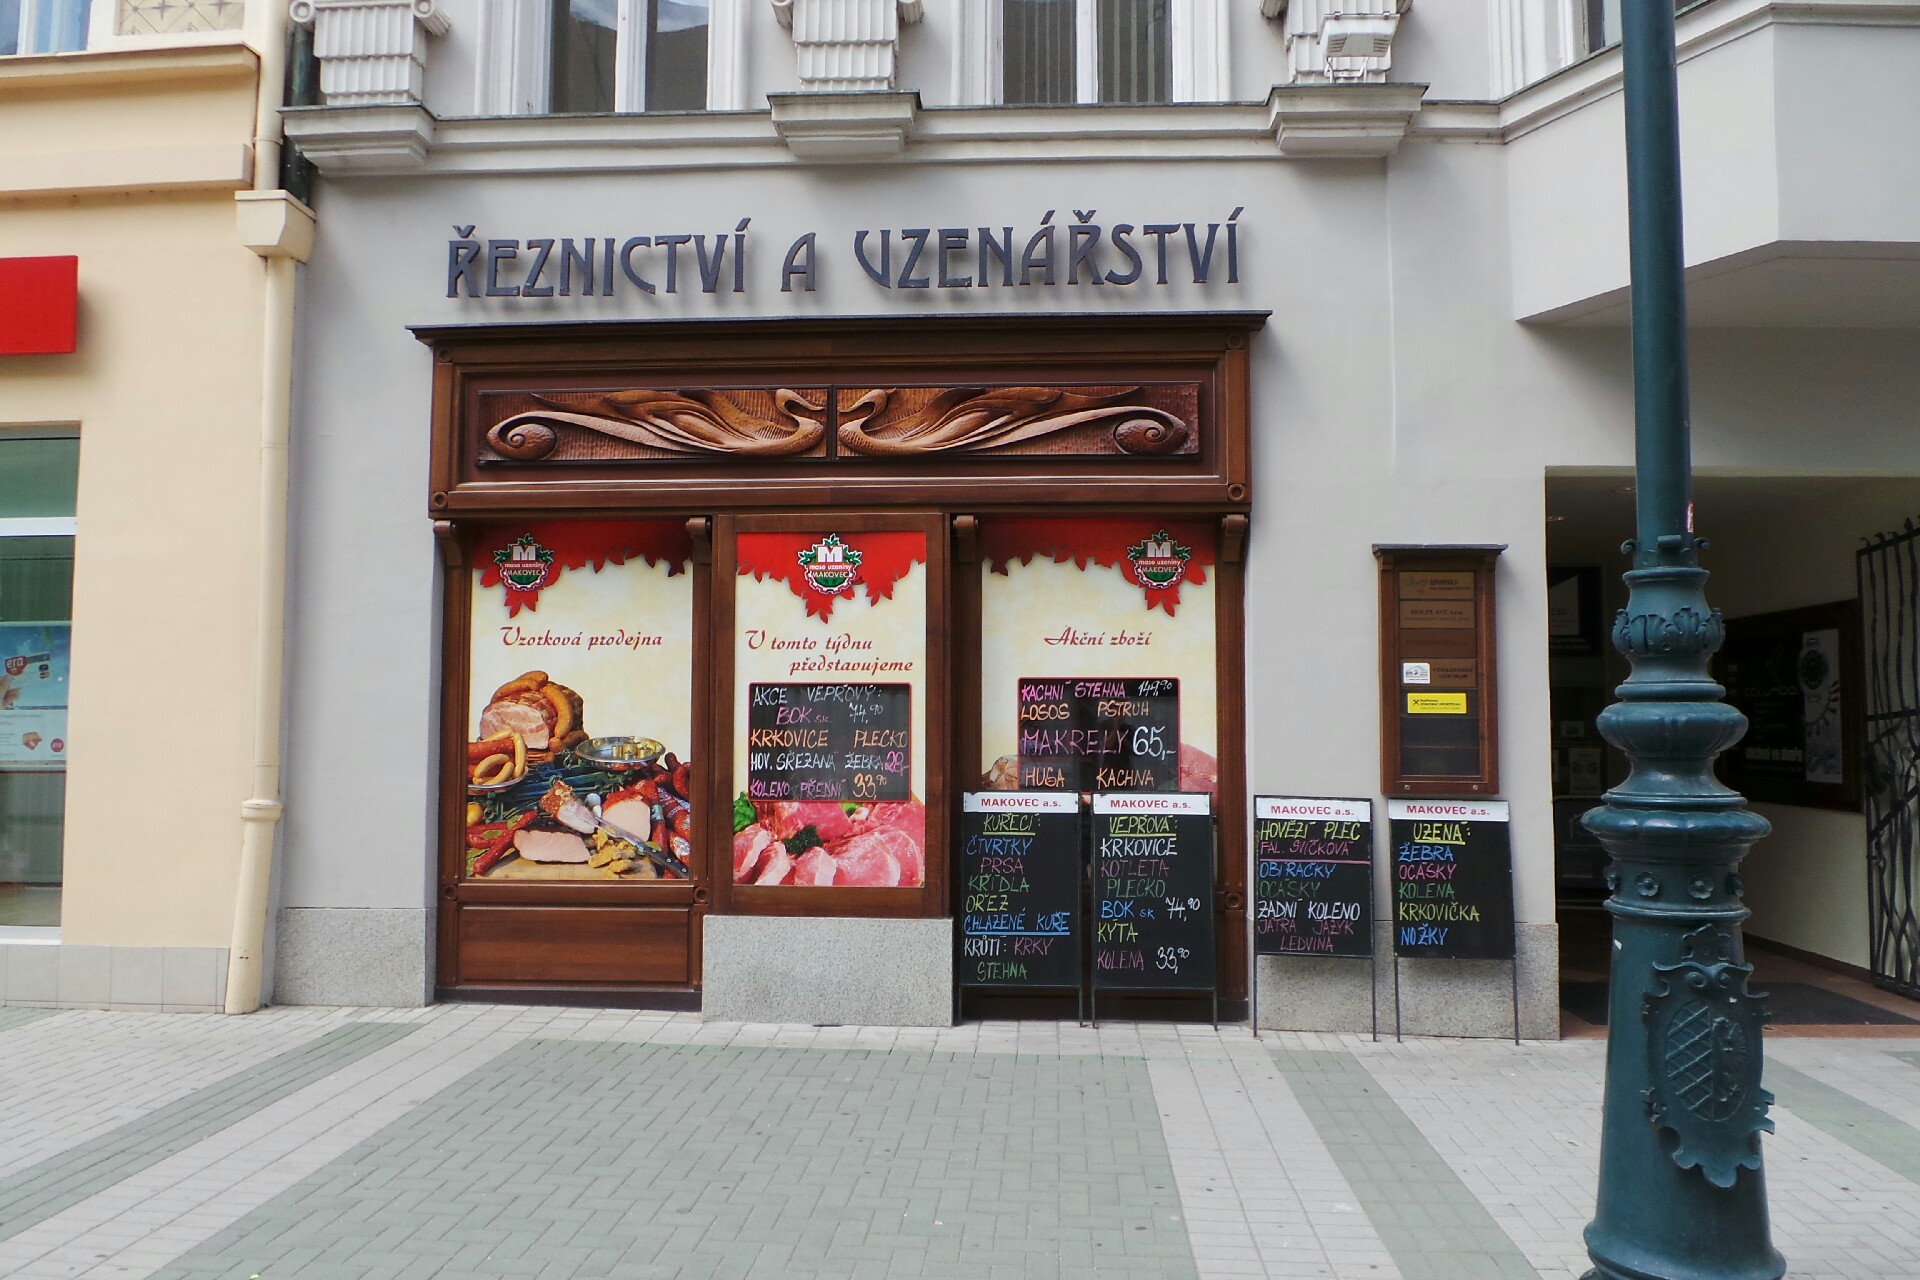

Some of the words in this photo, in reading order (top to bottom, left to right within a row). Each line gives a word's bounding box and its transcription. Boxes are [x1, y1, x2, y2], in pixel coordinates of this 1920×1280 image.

[447, 218, 752, 298] ŘEZNICTVÍ
[781, 232, 817, 293] A
[854, 207, 1244, 289] UZENÁŘSTVÍ
[587, 629, 662, 651] prodejna
[771, 637, 817, 650] tomto
[826, 633, 872, 655] týdnu
[1043, 626, 1105, 646] Akční
[1110, 629, 1153, 646] zboží
[790, 654, 913, 676] představujeme
[753, 686, 788, 707] AKCE
[1074, 682, 1126, 698] STEHNA
[776, 706, 812, 725] BOK
[1021, 703, 1070, 721] LOSOS
[1098, 700, 1149, 717] PSTRUH
[751, 728, 829, 749] KRKOVICE
[854, 729, 908, 748] PLECKO
[1023, 729, 1129, 756] MAKRELY
[751, 753, 774, 772] HOV.
[1096, 767, 1155, 790] KACHNA
[981, 798, 1039, 807] MAKOVEC
[1042, 799, 1061, 807] a.s.
[1110, 799, 1169, 809] MAKOVEC
[1172, 802, 1191, 810] a.s.
[1270, 805, 1332, 815] MAKOVEC
[1334, 807, 1354, 816] a.s.
[1406, 805, 1467, 816] MAKOVEC
[1470, 808, 1490, 816] a.s.
[1323, 821, 1361, 841] PLEC
[966, 834, 1033, 856] ČTVRTKY
[1100, 837, 1178, 858] KRKOVICE
[1399, 842, 1454, 863] ŽEBRA
[980, 856, 1024, 875] PRSA
[1100, 859, 1170, 878] KOTLETA
[1106, 878, 1166, 899] PLECKO
[1398, 881, 1455, 900] KOLENA
[1100, 899, 1136, 919] BOK
[1308, 900, 1361, 922] KOLENO
[1399, 901, 1480, 922] KRKOVIČKA
[1036, 911, 1071, 932] KUŘE
[1280, 935, 1335, 953] LEDVINA
[1401, 923, 1448, 947] NOŽKY
[1014, 937, 1054, 956] KRKY
[1097, 949, 1144, 971] KOLENA
[977, 961, 1028, 982] STEHNA
